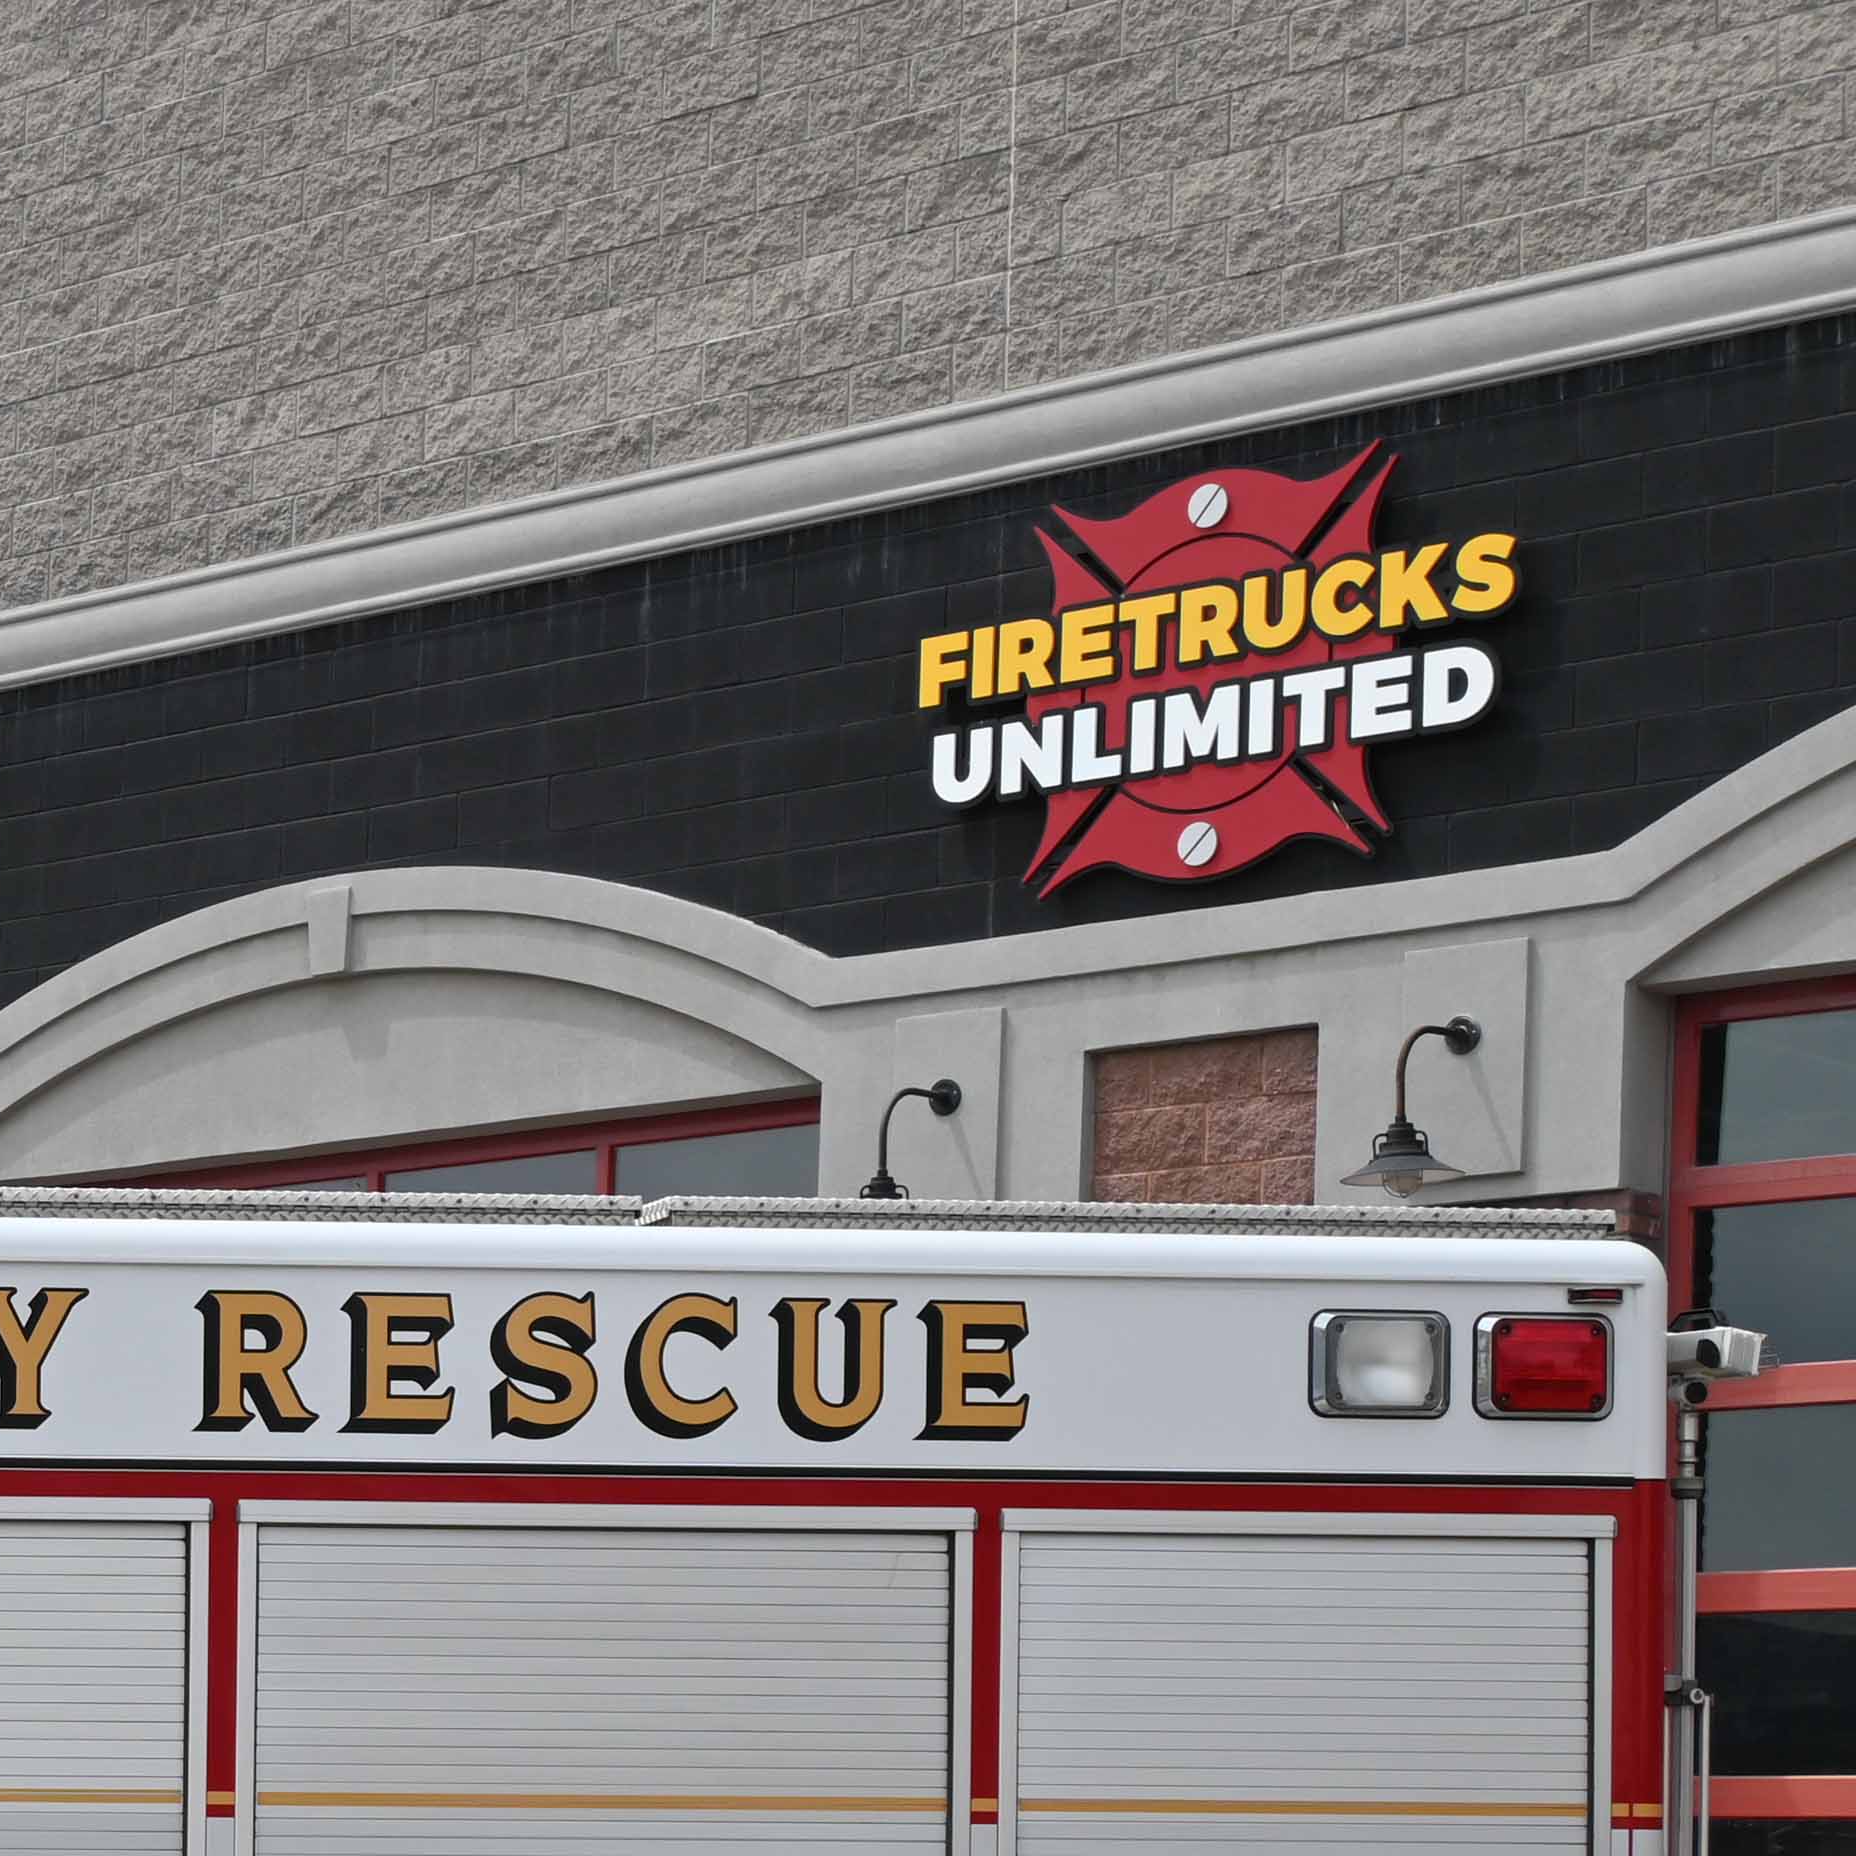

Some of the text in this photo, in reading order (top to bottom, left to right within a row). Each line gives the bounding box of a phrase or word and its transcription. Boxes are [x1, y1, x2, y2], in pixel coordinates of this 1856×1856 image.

[918, 533, 1517, 709] FIRETRUCKS
[931, 645, 1495, 804] UNLIMITED
[192, 1289, 1031, 1443] RESCUE
